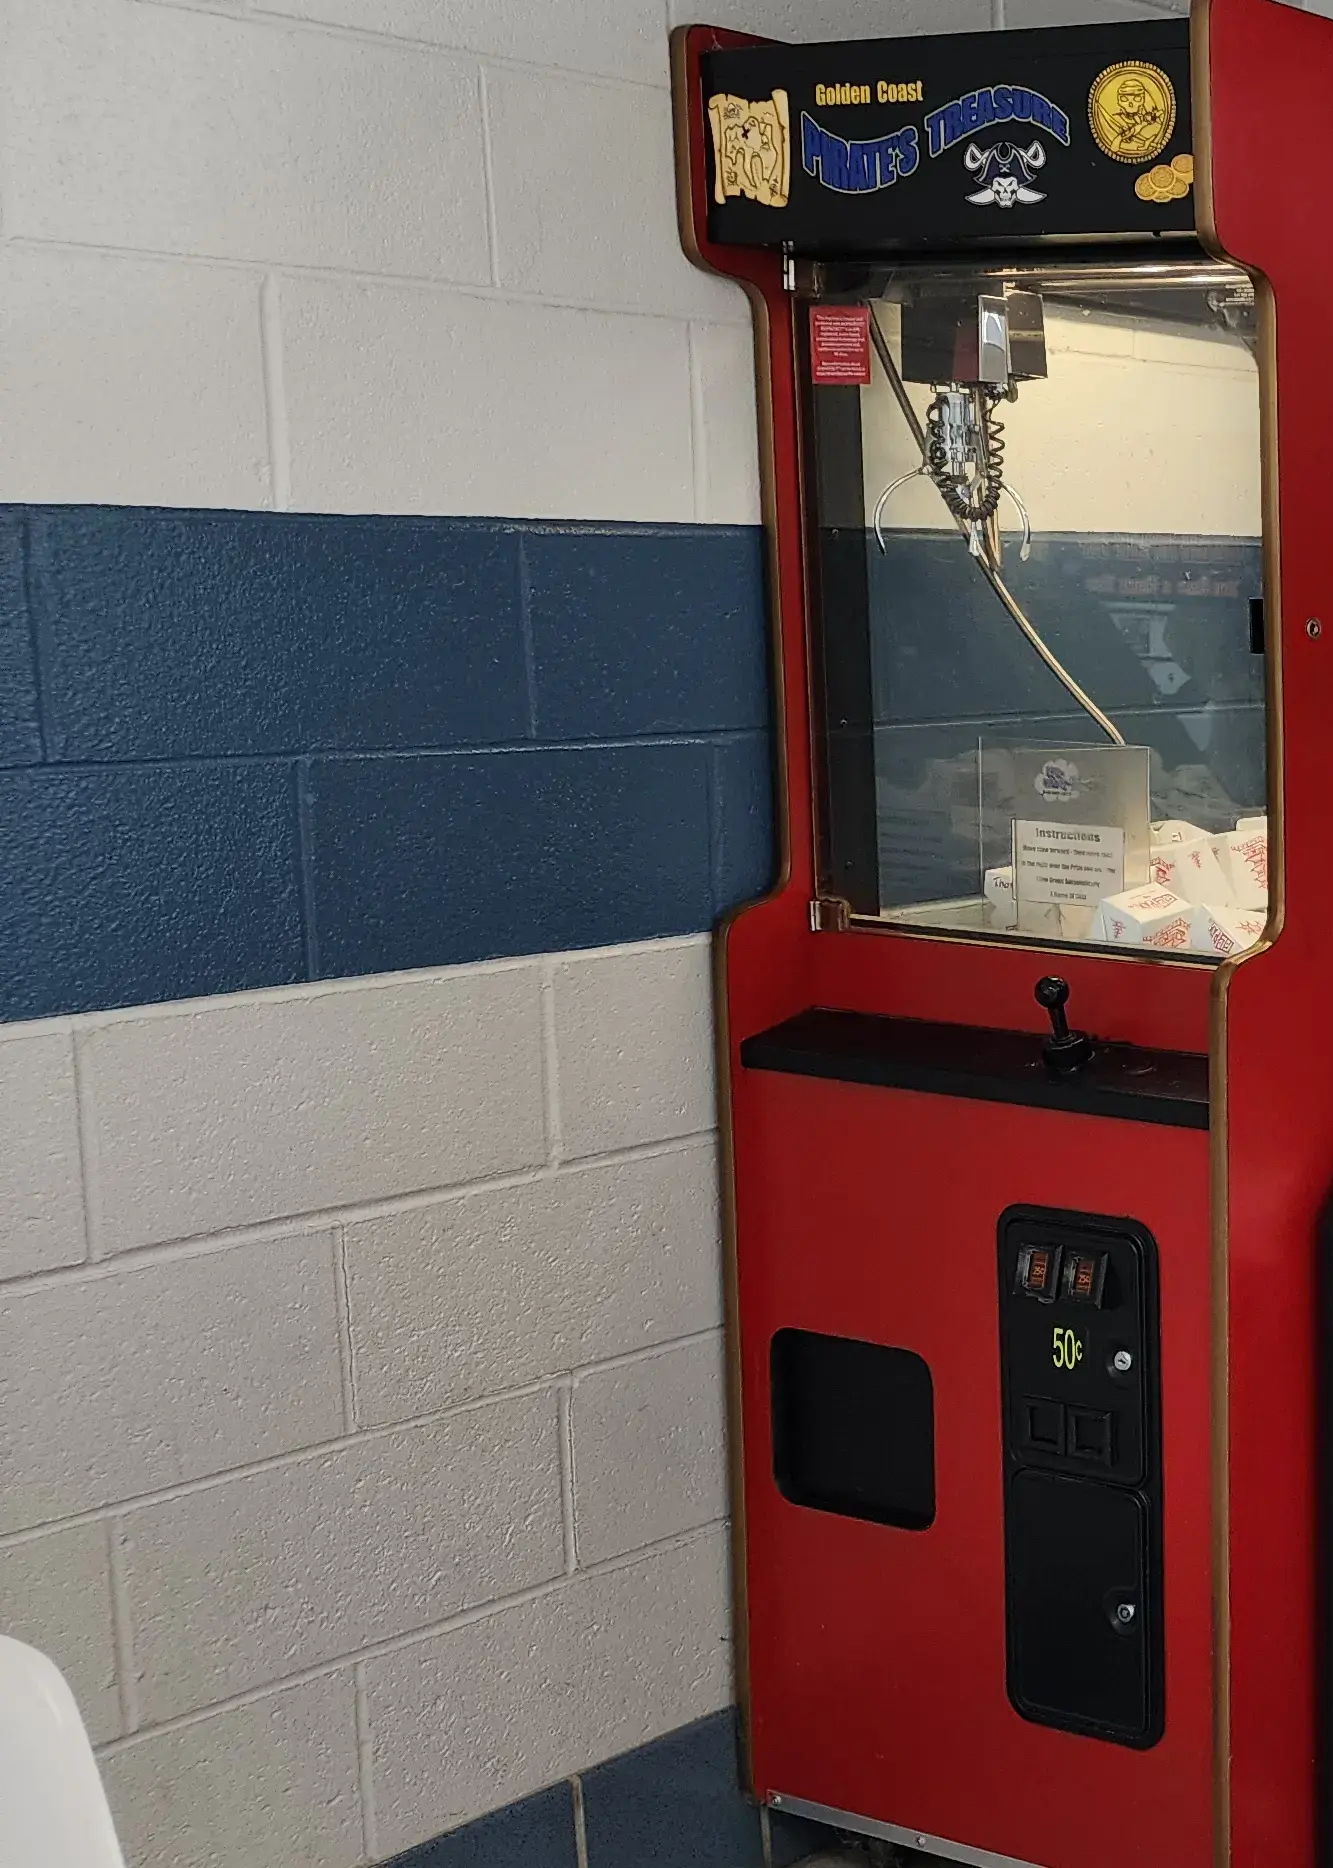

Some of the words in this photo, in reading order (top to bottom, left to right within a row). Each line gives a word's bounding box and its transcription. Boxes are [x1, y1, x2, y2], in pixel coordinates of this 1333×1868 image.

[815, 83, 873, 106] Golden
[877, 80, 923, 103] Coast
[801, 111, 919, 194] PIRATE'S
[925, 85, 1070, 157] TREASURE
[1036, 828, 1101, 843] Instructions
[1052, 1327, 1083, 1370] 50¢
